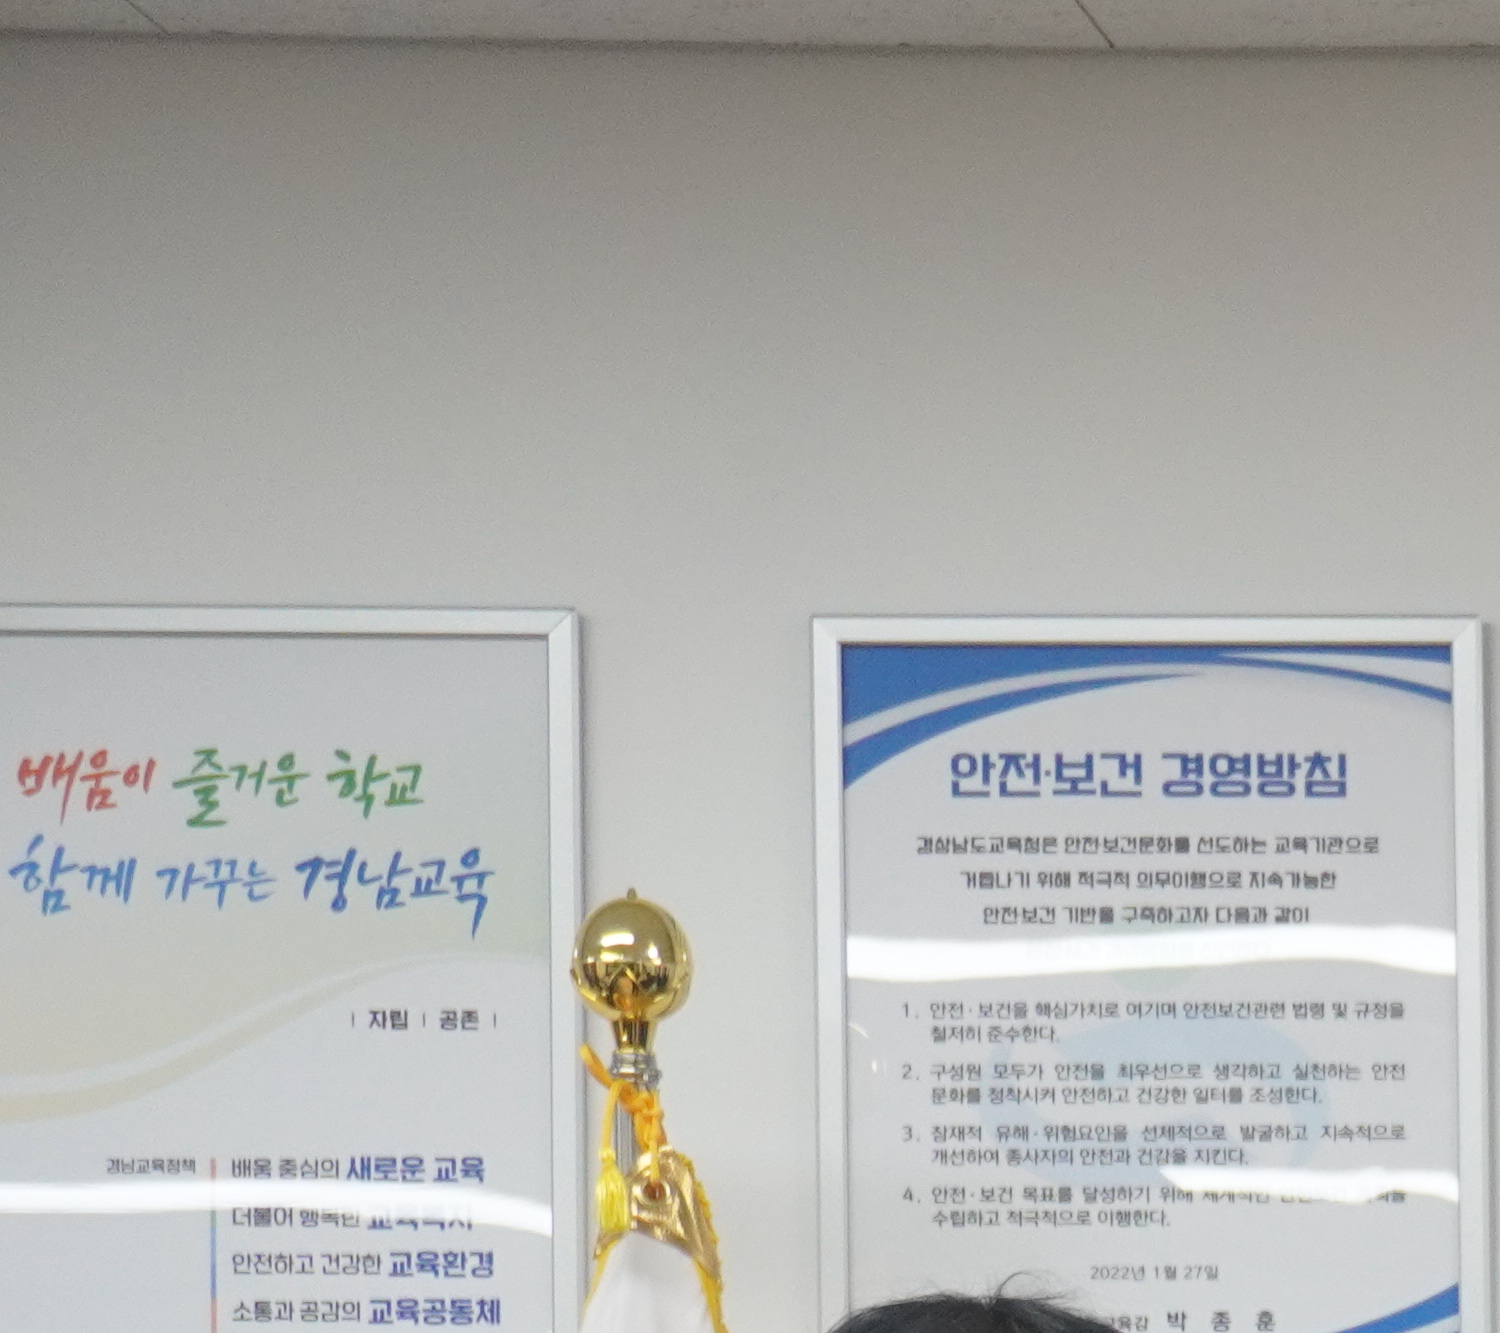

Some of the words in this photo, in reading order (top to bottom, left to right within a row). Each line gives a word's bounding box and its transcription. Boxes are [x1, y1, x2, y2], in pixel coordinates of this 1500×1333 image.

[950, 751, 1143, 799] 안전·보건
[1161, 751, 1347, 799] 경영방침
[17, 749, 156, 825] 배움이
[172, 747, 310, 828] 즐거운
[326, 749, 425, 818] 학교
[1197, 836, 1267, 854] 선도하는
[1275, 836, 1379, 854] 교육기관으로
[9, 834, 138, 916] 함께
[156, 857, 278, 909] 가꾸는
[294, 846, 495, 939] 경남교육
[1037, 871, 1071, 889] 위해
[1078, 871, 1130, 889] 적극적
[1137, 871, 1242, 889] 의무이행으로
[1250, 871, 1336, 889] 지속가능한
[1063, 906, 1114, 924] 기반을
[1122, 906, 1208, 924] 구축하고자
[1216, 906, 1267, 924] 다음과
[1275, 906, 1309, 924] 같이
[368, 1009, 408, 1030] 자립
[438, 1009, 480, 1030] 공존
[902, 1002, 919, 1019] 1.
[1036, 1002, 1120, 1019] 핵심가치로
[1126, 1002, 1176, 1019] 여기며
[1183, 1002, 1285, 1019] 안전보건관련
[1292, 1002, 1325, 1019] 법령
[1332, 1002, 1347, 1019] 및
[1355, 1002, 1404, 1019] 규정을
[931, 1026, 981, 1043] 철저히
[987, 1026, 1059, 1043] 준수한다.
[902, 1063, 920, 1081] 2.
[930, 1063, 981, 1081] 구성원
[993, 1063, 1042, 1081] 모두가
[1055, 1063, 1104, 1081] 안전을
[1117, 1063, 1202, 1081] 최우선으로
[1214, 1063, 1281, 1081] 생각하고
[1292, 1063, 1360, 1081] 실천하는
[1372, 1063, 1405, 1081] 안전
[931, 1087, 980, 1104] 문화를
[988, 1087, 1055, 1104] 정착시켜
[1062, 1087, 1130, 1104] 안전하고
[1136, 1087, 1187, 1104] 건강한
[1193, 1087, 1242, 1104] 일터를
[1251, 1087, 1322, 1104] 조성한다.
[902, 1125, 921, 1142] 3.
[931, 1125, 982, 1142] 잠재적
[1141, 1125, 1226, 1142] 선제적으로
[1240, 1125, 1308, 1142] 발굴하고
[1321, 1125, 1406, 1142] 지속적으로
[932, 1149, 999, 1166] 개선하여
[1006, 1149, 1073, 1166] 종사자의
[1080, 1149, 1130, 1166] 안전과
[1138, 1149, 1187, 1166] 건강을
[1194, 1149, 1249, 1166] 지킨다.
[232, 1158, 271, 1179] 배움
[279, 1158, 339, 1179] 중심의
[347, 1155, 424, 1182] 새로운
[433, 1156, 484, 1183] 교육
[902, 1187, 921, 1204] 4.
[1022, 1187, 1072, 1204] 목표를
[1082, 1186, 1150, 1204] 달성하기
[932, 1210, 1000, 1227] 수립하고
[1007, 1210, 1091, 1227] 적극적으로
[1100, 1210, 1170, 1227] 이행한다.
[232, 1252, 314, 1276] 안전하고
[320, 1252, 382, 1276] 건강한
[388, 1249, 494, 1279] 교육환경
[1090, 1265, 1145, 1281] 2022년
[1154, 1265, 1176, 1281] 1월
[1184, 1265, 1218, 1281] 27일
[232, 1300, 294, 1323] 소통과
[299, 1300, 361, 1323] 공감의
[368, 1297, 500, 1326] 교육공동체
[1167, 1311, 1187, 1332] 박
[1211, 1311, 1231, 1332] 종
[1255, 1310, 1276, 1332] 훈
